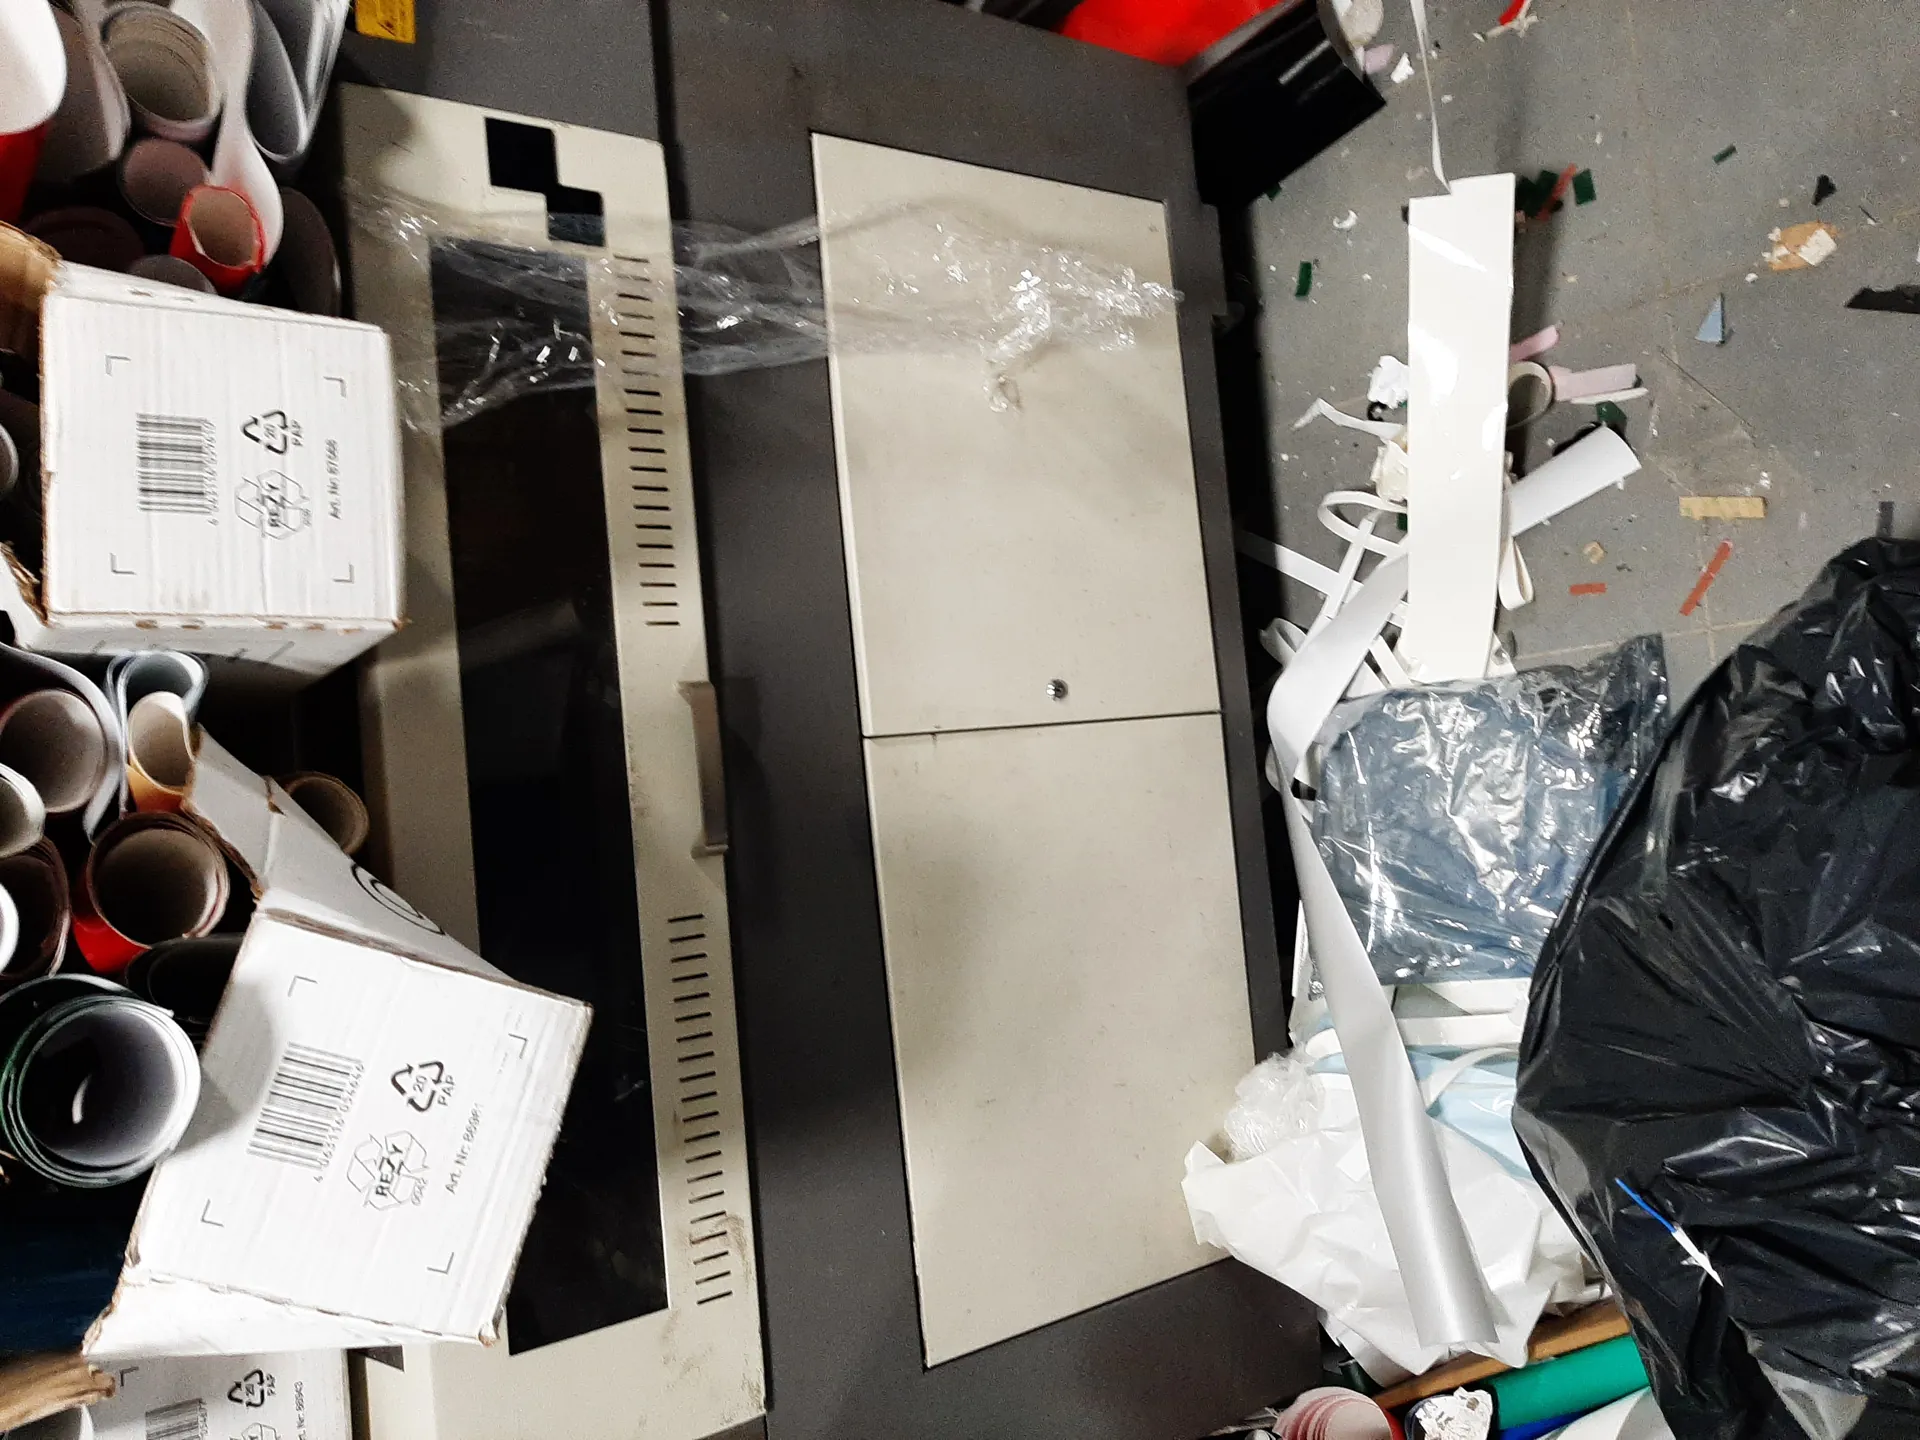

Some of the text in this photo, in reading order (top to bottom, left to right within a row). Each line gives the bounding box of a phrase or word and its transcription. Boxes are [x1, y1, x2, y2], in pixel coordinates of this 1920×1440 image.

[290, 419, 304, 447] PAP
[339, 1063, 364, 1114] 054646
[412, 1074, 428, 1093] 20
[436, 1074, 454, 1107] PAP
[453, 1145, 470, 1166] Nr.
[445, 1171, 463, 1195] Art.
[266, 1373, 276, 1397] PAP
